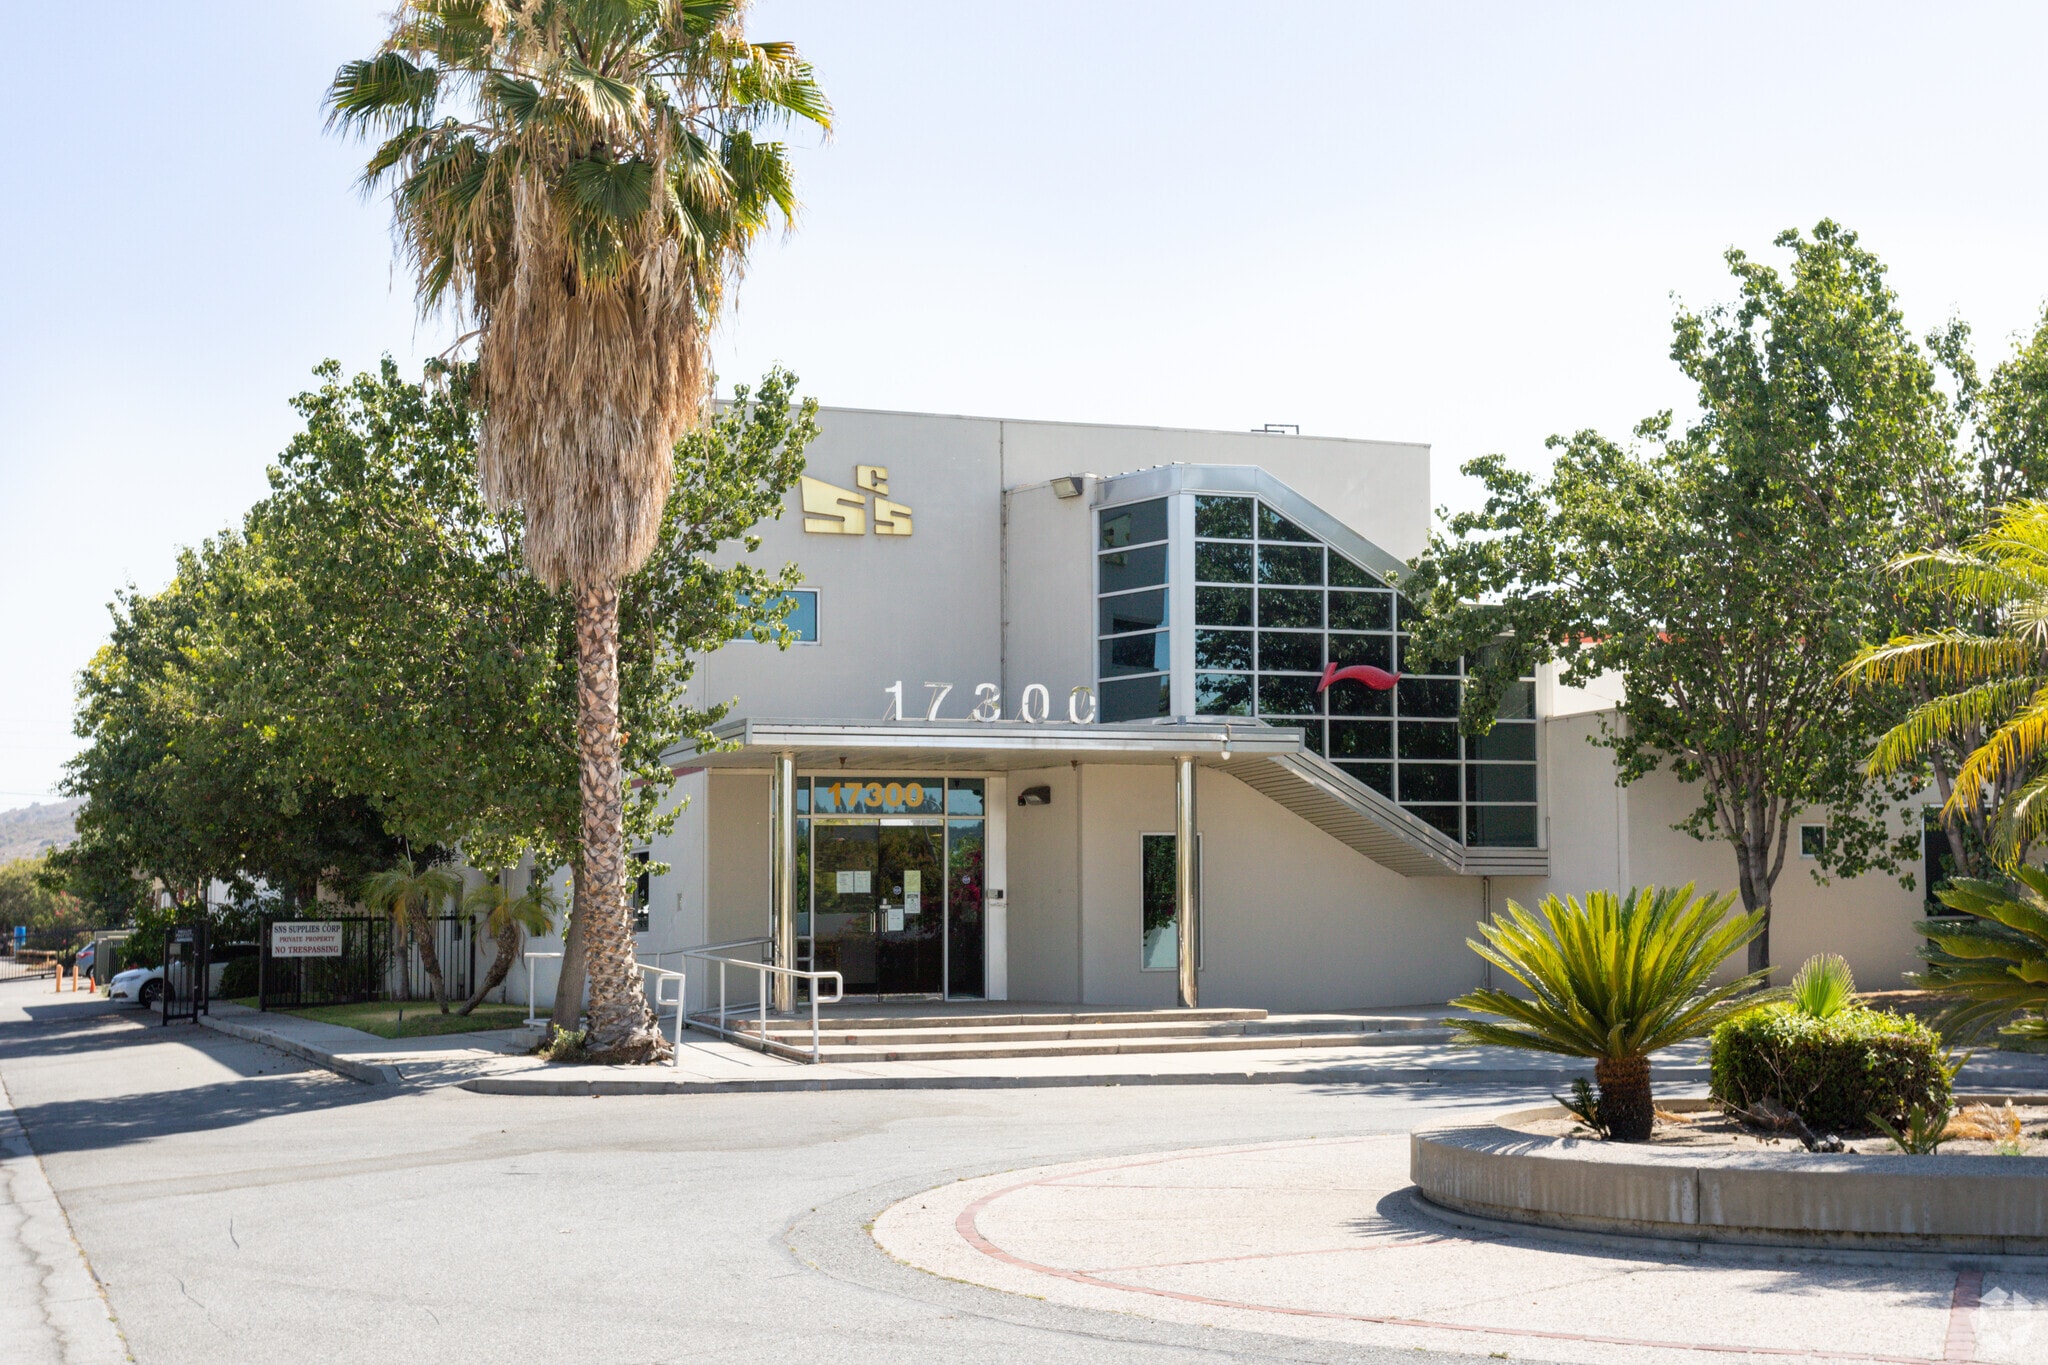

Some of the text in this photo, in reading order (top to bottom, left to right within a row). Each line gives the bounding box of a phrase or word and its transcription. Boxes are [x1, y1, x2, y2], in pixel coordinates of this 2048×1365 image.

[885, 680, 1096, 724] 17300
[827, 782, 924, 807] 17300
[274, 924, 341, 933] SNS SUPPLIES CORP
[275, 945, 339, 954] NO TRESPASSING
